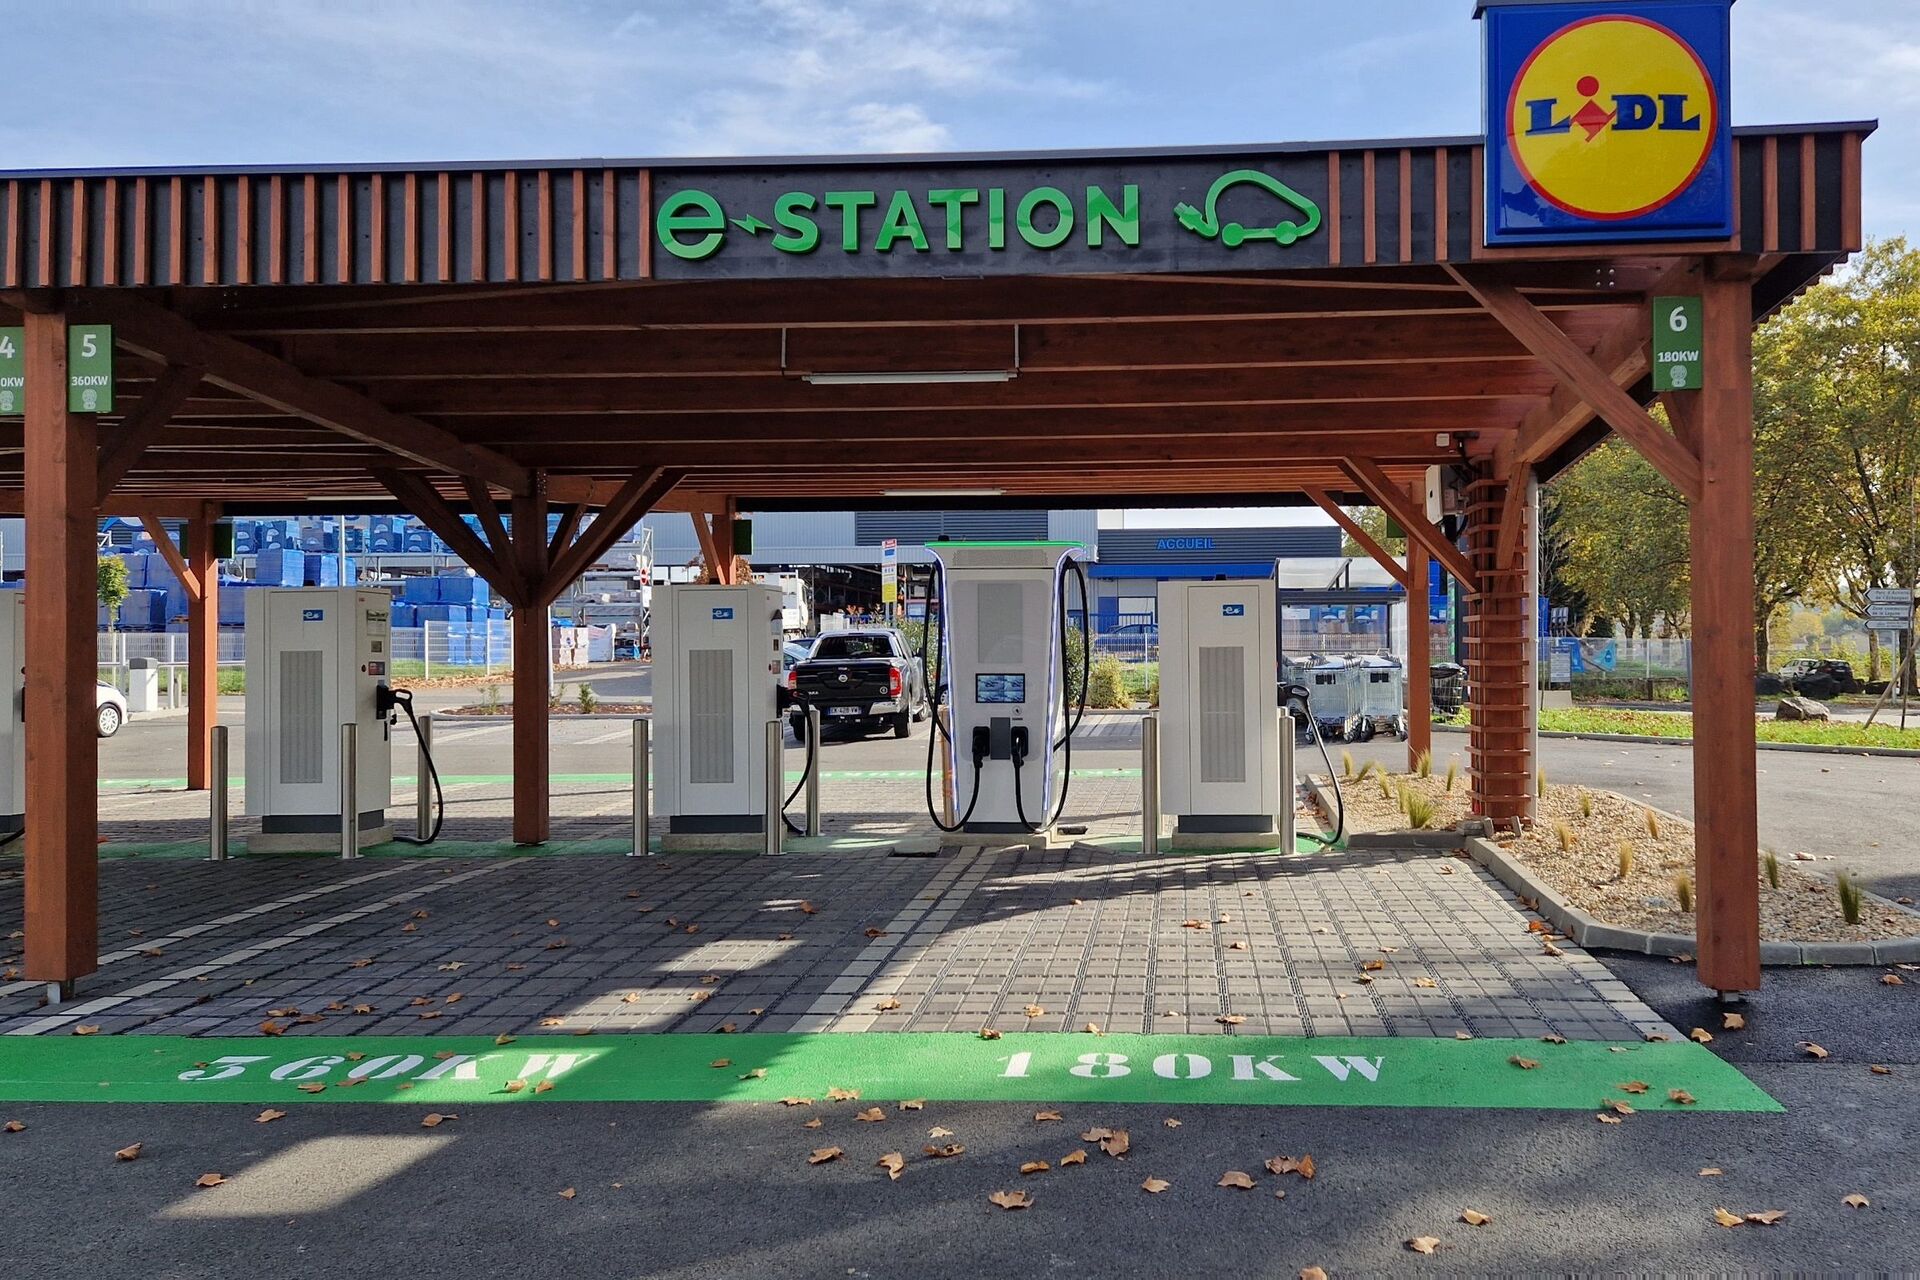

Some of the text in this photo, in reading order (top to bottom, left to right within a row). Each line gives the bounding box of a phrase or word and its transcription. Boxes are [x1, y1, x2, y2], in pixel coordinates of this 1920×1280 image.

[1669, 306, 1688, 332] 6
[0, 335, 15, 359] 4
[81, 334, 97, 358] 5
[1657, 350, 1699, 362] 180KW
[71, 375, 109, 386] 360KW
[1156, 537, 1216, 550] ACCUEIL
[178, 1054, 600, 1081] 360KW
[997, 1052, 1385, 1082] 180KW
